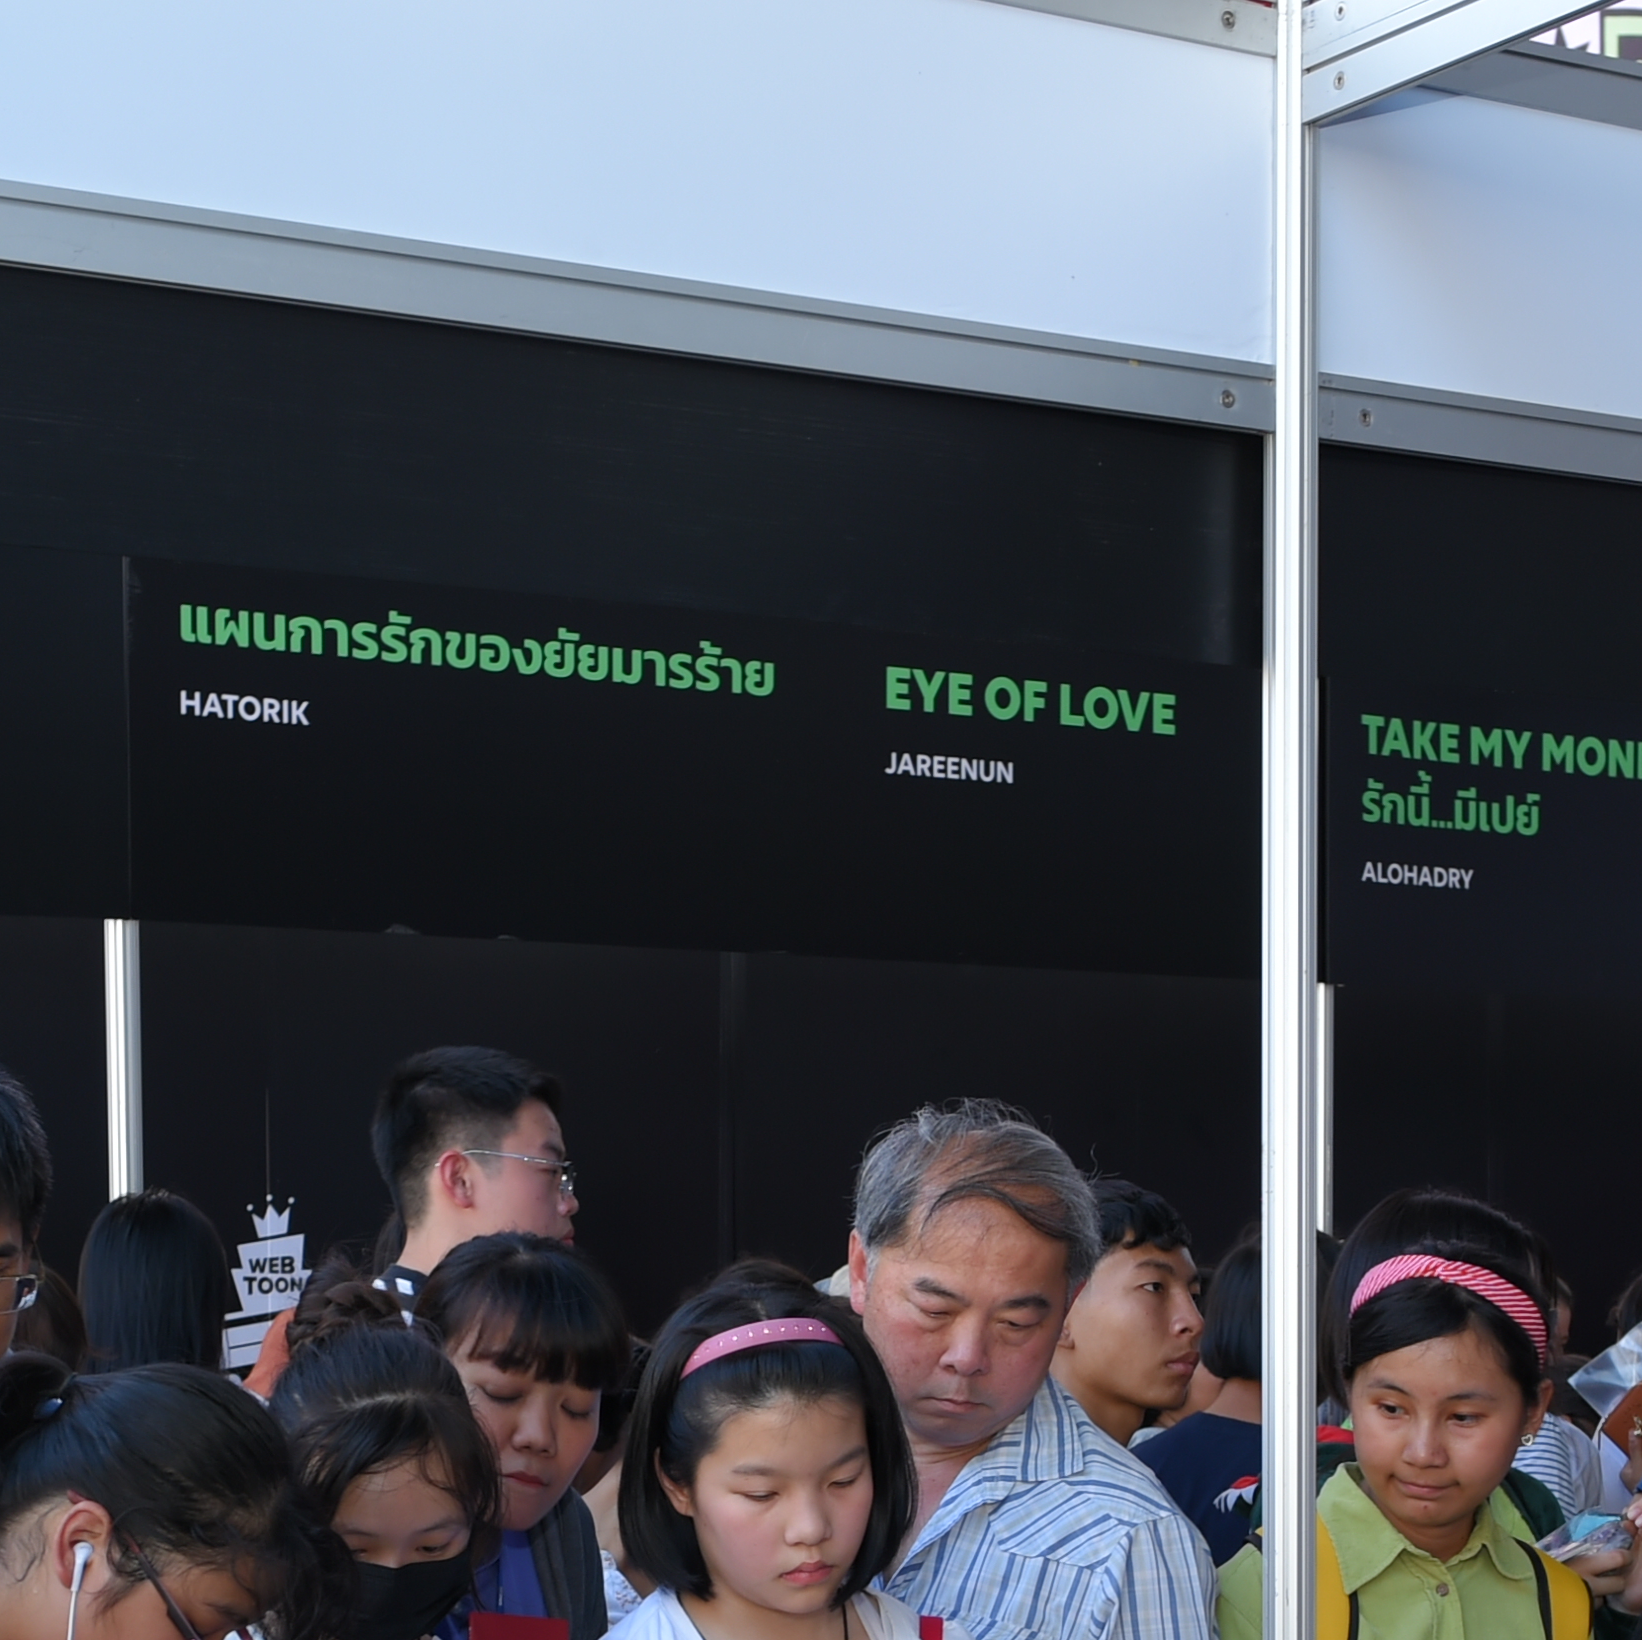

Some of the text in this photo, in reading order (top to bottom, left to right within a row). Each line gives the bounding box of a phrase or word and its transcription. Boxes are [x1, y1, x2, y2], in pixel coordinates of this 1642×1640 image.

[180, 603, 777, 698] แผนการรักของยัยมารร้าย
[180, 689, 310, 726] HATORIK
[886, 666, 1177, 735] EYE OF LOVE
[1362, 714, 1460, 763] TAKE
[1470, 727, 1532, 768] MY
[884, 751, 1014, 784] JAREENUN
[1361, 770, 1541, 837] รักนี้...มีเปย์
[1361, 861, 1474, 890] ALOHADRY
[248, 1256, 296, 1274] WEB
[243, 1276, 304, 1296] TOON
